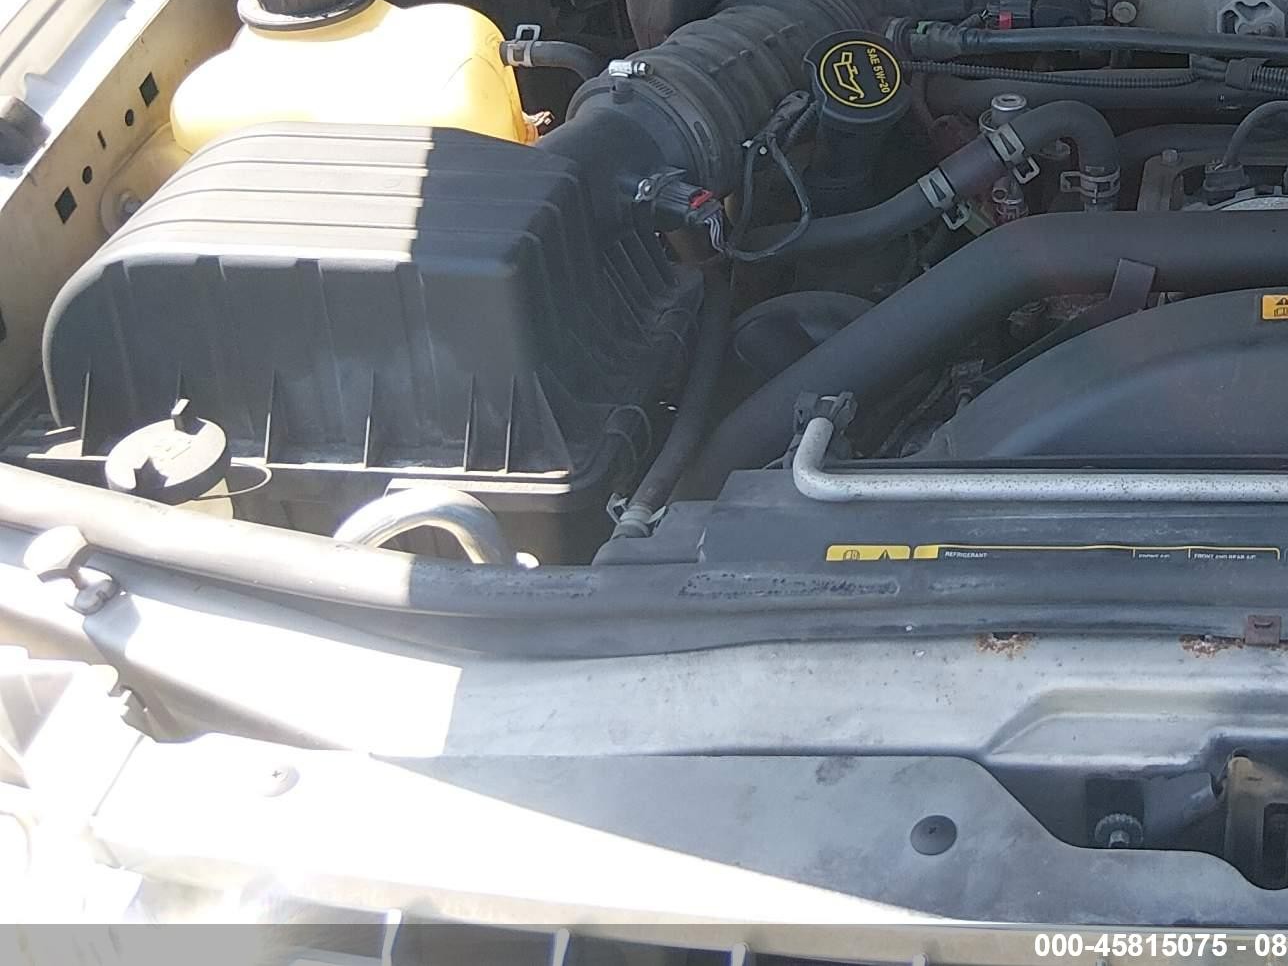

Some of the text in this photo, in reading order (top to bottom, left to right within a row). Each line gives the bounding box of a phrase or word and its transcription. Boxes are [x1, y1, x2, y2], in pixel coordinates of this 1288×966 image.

[867, 47, 891, 94] SAE 5W-20
[944, 551, 988, 559] REFRIGERANT
